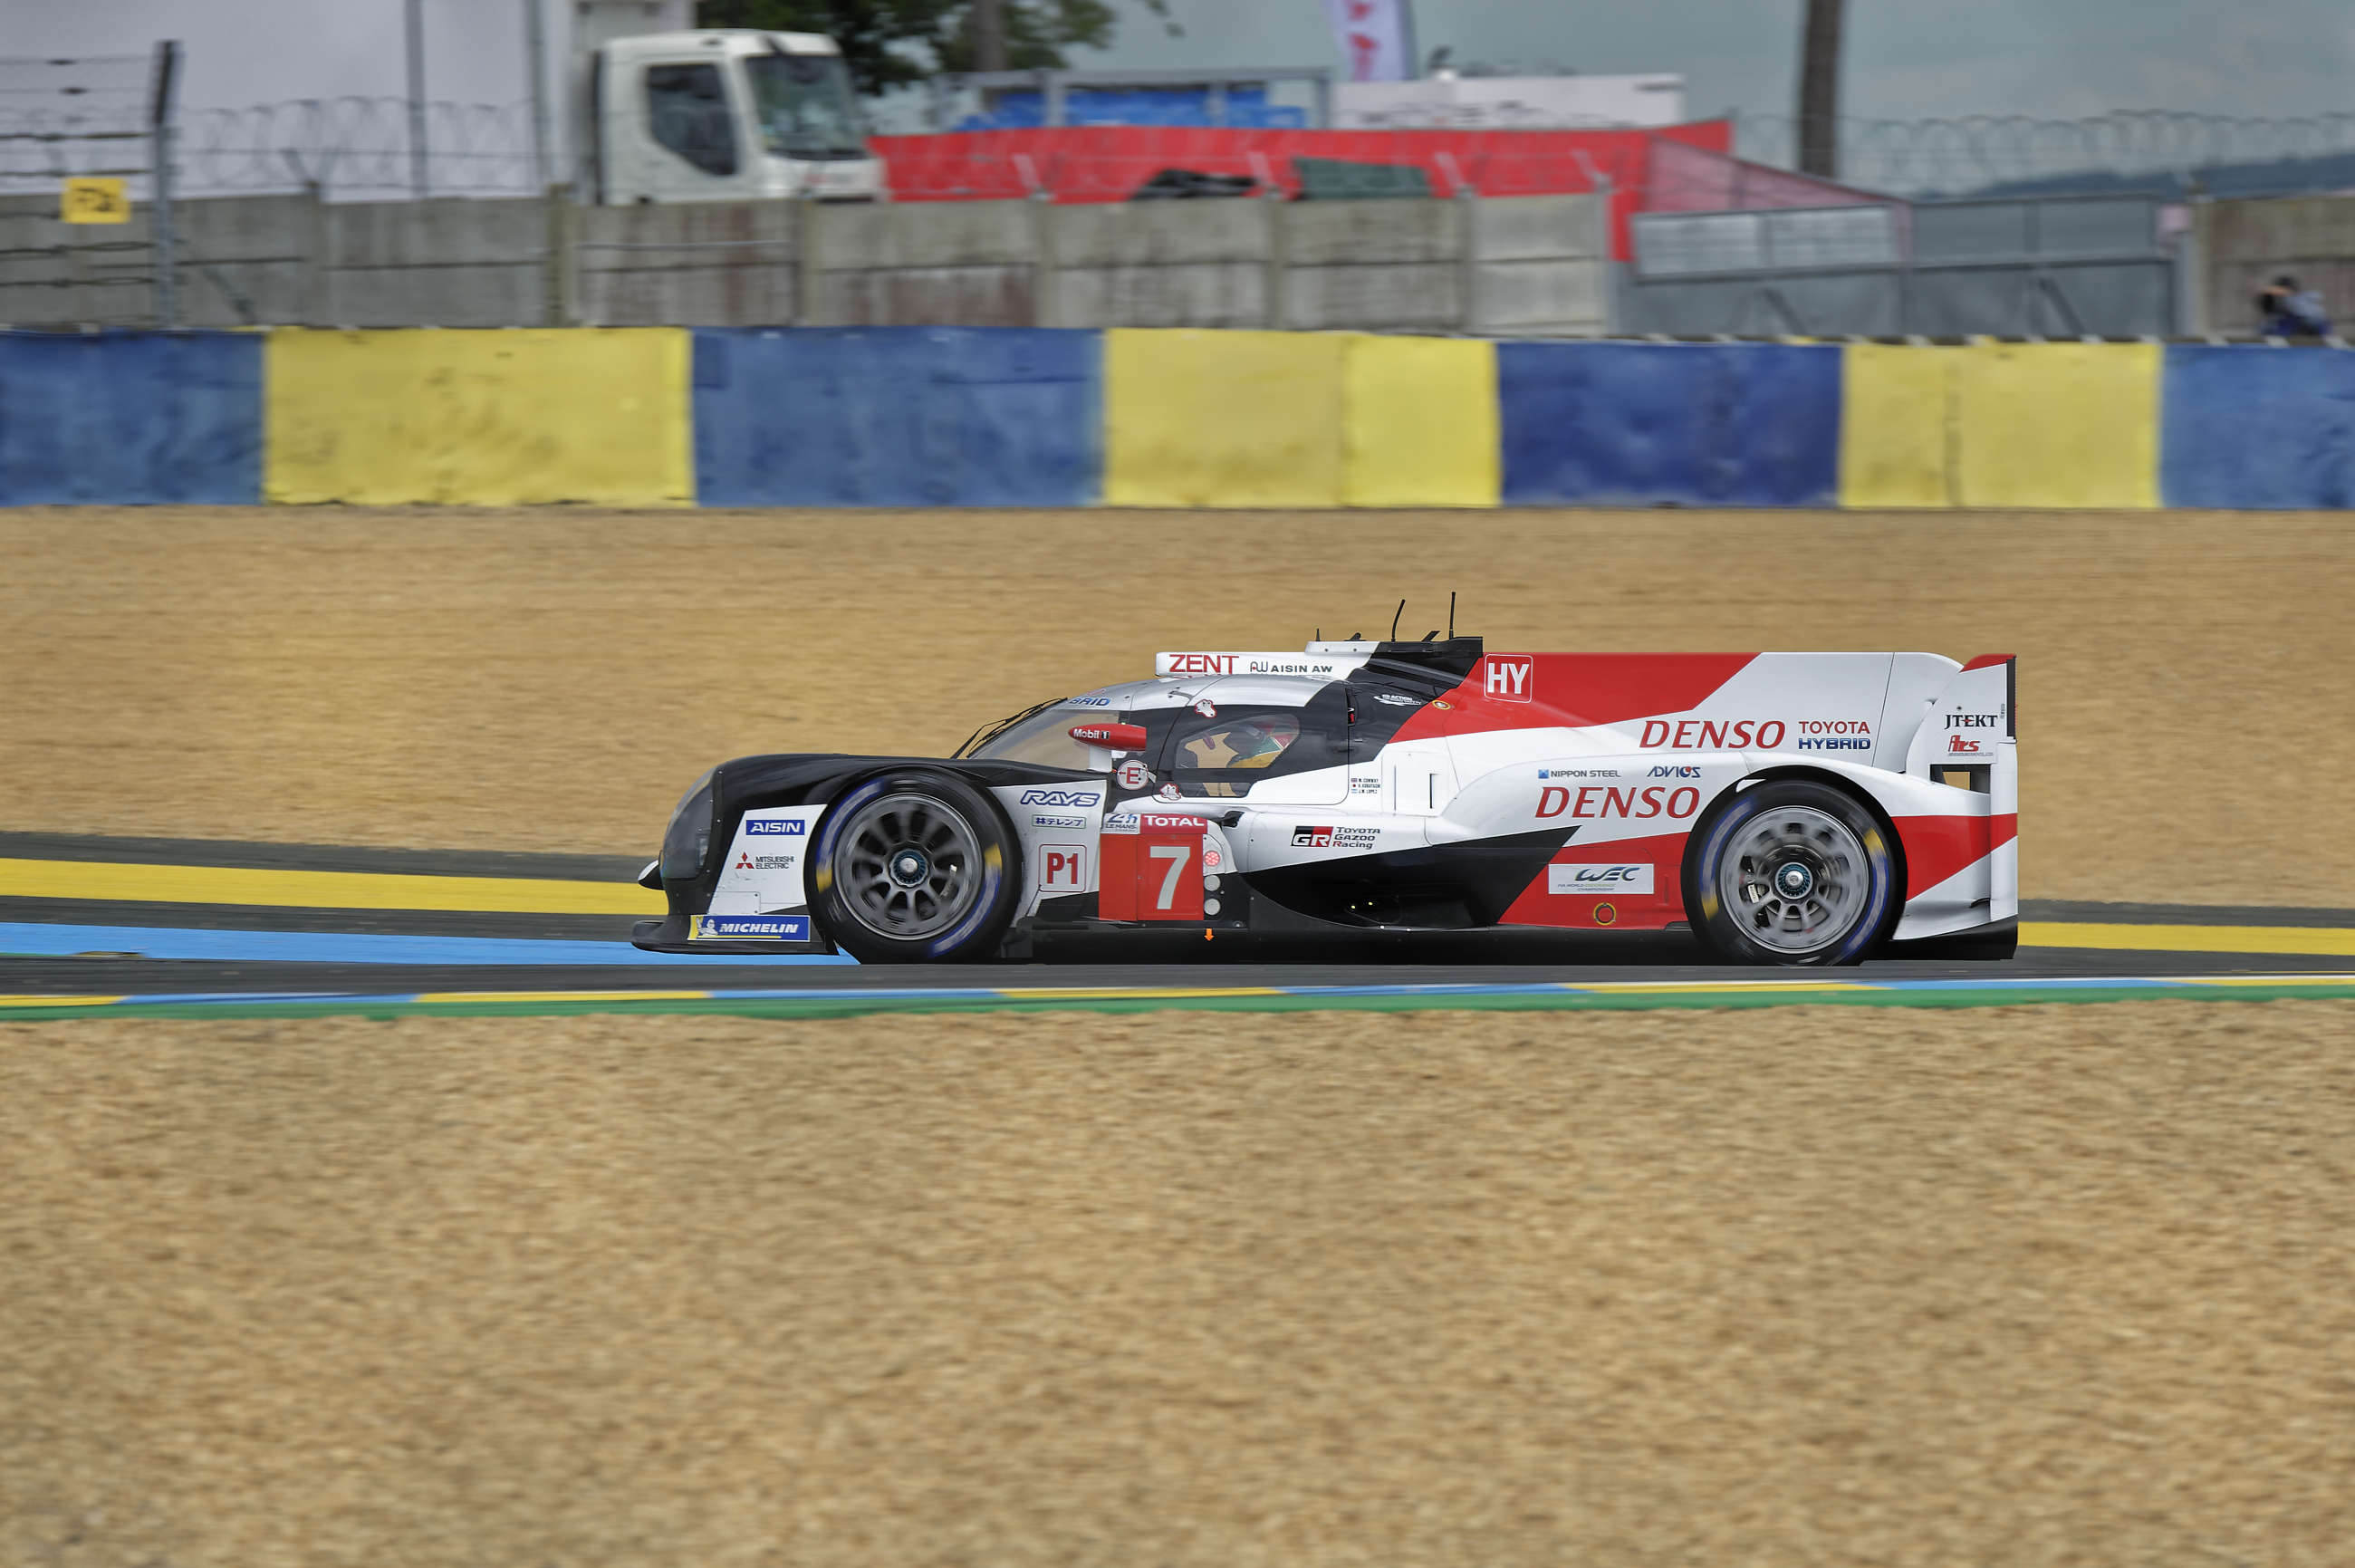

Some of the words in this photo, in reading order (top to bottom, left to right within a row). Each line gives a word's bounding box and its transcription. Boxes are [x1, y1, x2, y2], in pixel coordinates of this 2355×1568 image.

[1169, 654, 1239, 675] ZENT
[1270, 665, 1308, 673] AISIN
[1312, 665, 1333, 673] AW
[1486, 662, 1530, 695] HY
[1799, 721, 1870, 734] TOYOTA
[1944, 714, 1998, 730] JTEKT
[1073, 728, 1101, 739] Mobil
[1639, 720, 1786, 749] DENSO
[1798, 738, 1871, 750] HYBRID
[1127, 767, 1139, 784] E
[1551, 770, 1588, 778] NIPPON
[1589, 770, 1621, 778] STEEL
[1020, 790, 1101, 807] RAYS
[1535, 786, 1700, 819] DENSO
[750, 822, 801, 833] AISIN
[1144, 815, 1205, 826] TOTAL
[1293, 833, 1331, 847] GR
[1332, 842, 1373, 850] Racing
[1046, 852, 1078, 885] P1
[1574, 866, 1640, 881] WEC
[1149, 846, 1190, 909] 7
[719, 923, 799, 934] MICHELIN
